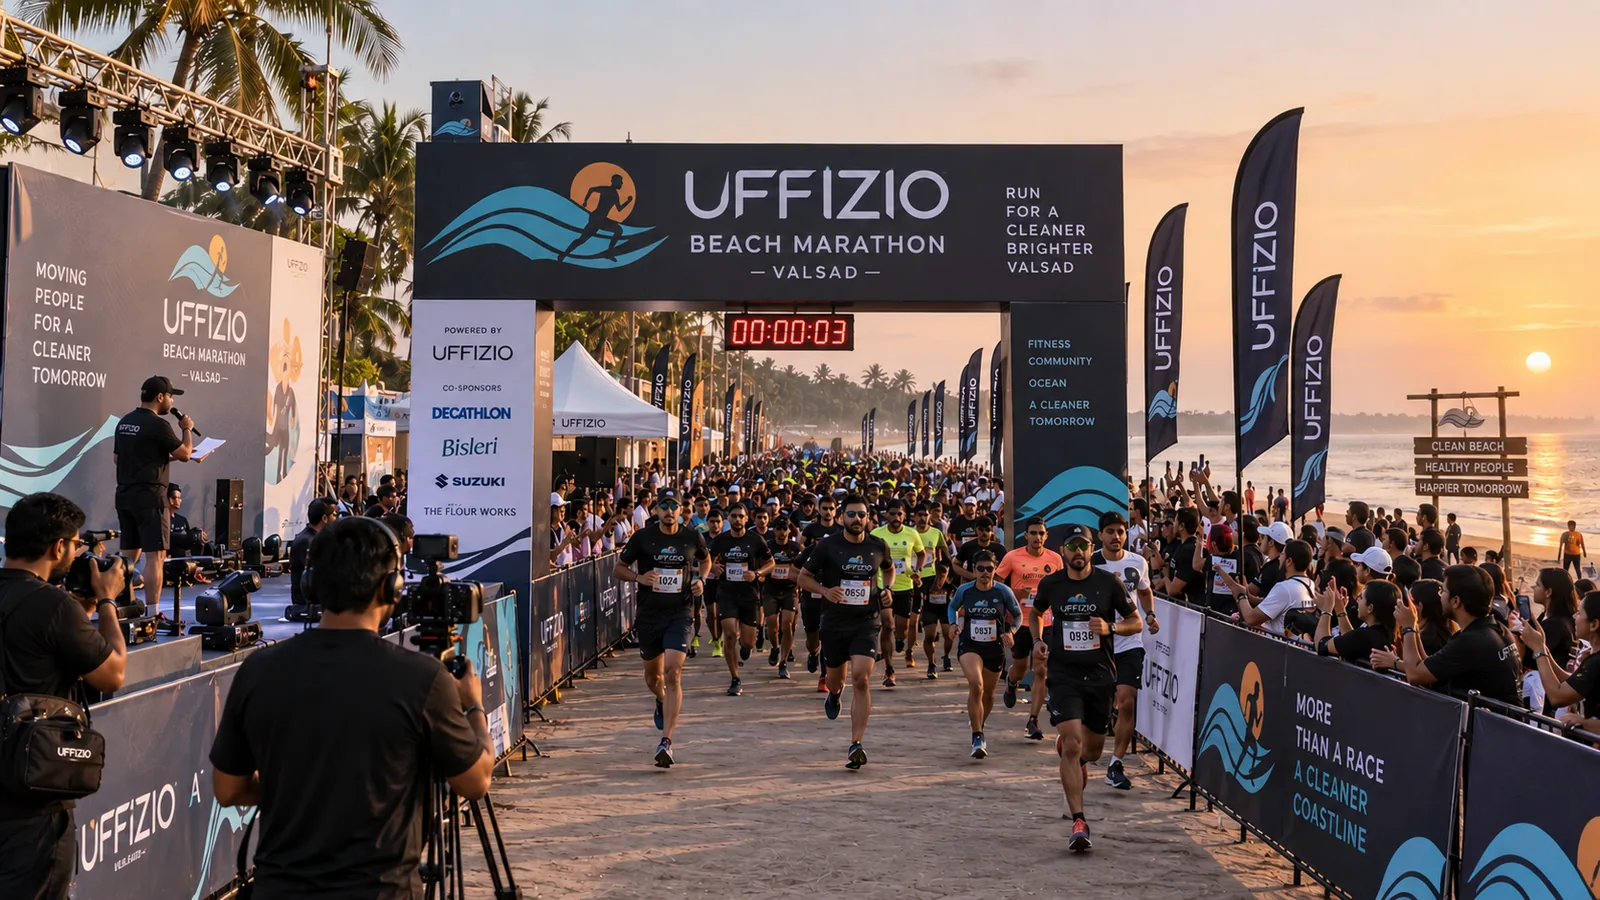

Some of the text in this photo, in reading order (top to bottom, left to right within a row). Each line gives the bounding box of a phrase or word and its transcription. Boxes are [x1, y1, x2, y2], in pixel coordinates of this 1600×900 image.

[685, 168, 949, 219] UFFIZIO
[1006, 187, 1040, 199] RUN
[1006, 206, 1059, 218] FOR A
[1006, 224, 1086, 236] CLEANER
[690, 235, 945, 253] BEACH MARATHON
[1007, 243, 1093, 255] BRIGHTER
[36, 261, 87, 286] MOVING
[772, 265, 858, 279] VALSAD
[1007, 261, 1074, 273] VALSAD
[1252, 201, 1278, 350] UFFIZIO
[35, 287, 84, 311] PEOPLE
[34, 313, 74, 335] FOR A
[163, 298, 247, 343] UFFIZIO
[1155, 266, 1173, 371] UFFIZIO
[732, 319, 847, 344] 00:00:03
[33, 340, 91, 362] CLEANER
[1028, 339, 1071, 349] FITNESS
[163, 343, 246, 366] BEACH MARATHON
[433, 345, 513, 361] UFFIZIO
[1028, 357, 1092, 366] COMMUNITY
[32, 366, 107, 388] TOMORROW
[189, 370, 221, 383] VALSAD
[1028, 379, 1067, 388] OCEAN
[1304, 335, 1323, 440] UFFIZIO
[1029, 400, 1090, 410] A CLEANER
[432, 407, 511, 420] DECATHLON
[561, 418, 606, 428] UFFIZIO
[1029, 417, 1095, 426] TOMORROW
[442, 437, 498, 457] Bisleri
[1432, 441, 1505, 452] CLEAN BEACH
[1425, 462, 1514, 473] HEALTHY PEOPLE
[452, 477, 505, 487] SUZUKI
[1420, 483, 1522, 495] HAPPIER TOMORROW
[424, 507, 517, 517] THE FLOUR WORKS
[659, 576, 678, 586] 1024
[1145, 658, 1179, 704] UFFIZIO
[1296, 692, 1332, 726] MORE
[57, 746, 92, 759] UFFIZIO
[1296, 725, 1385, 784] THAN A RACE
[1294, 759, 1368, 816] A CLEANER
[81, 783, 176, 872] UFFIZIO
[1293, 792, 1368, 854] COASTLINE
